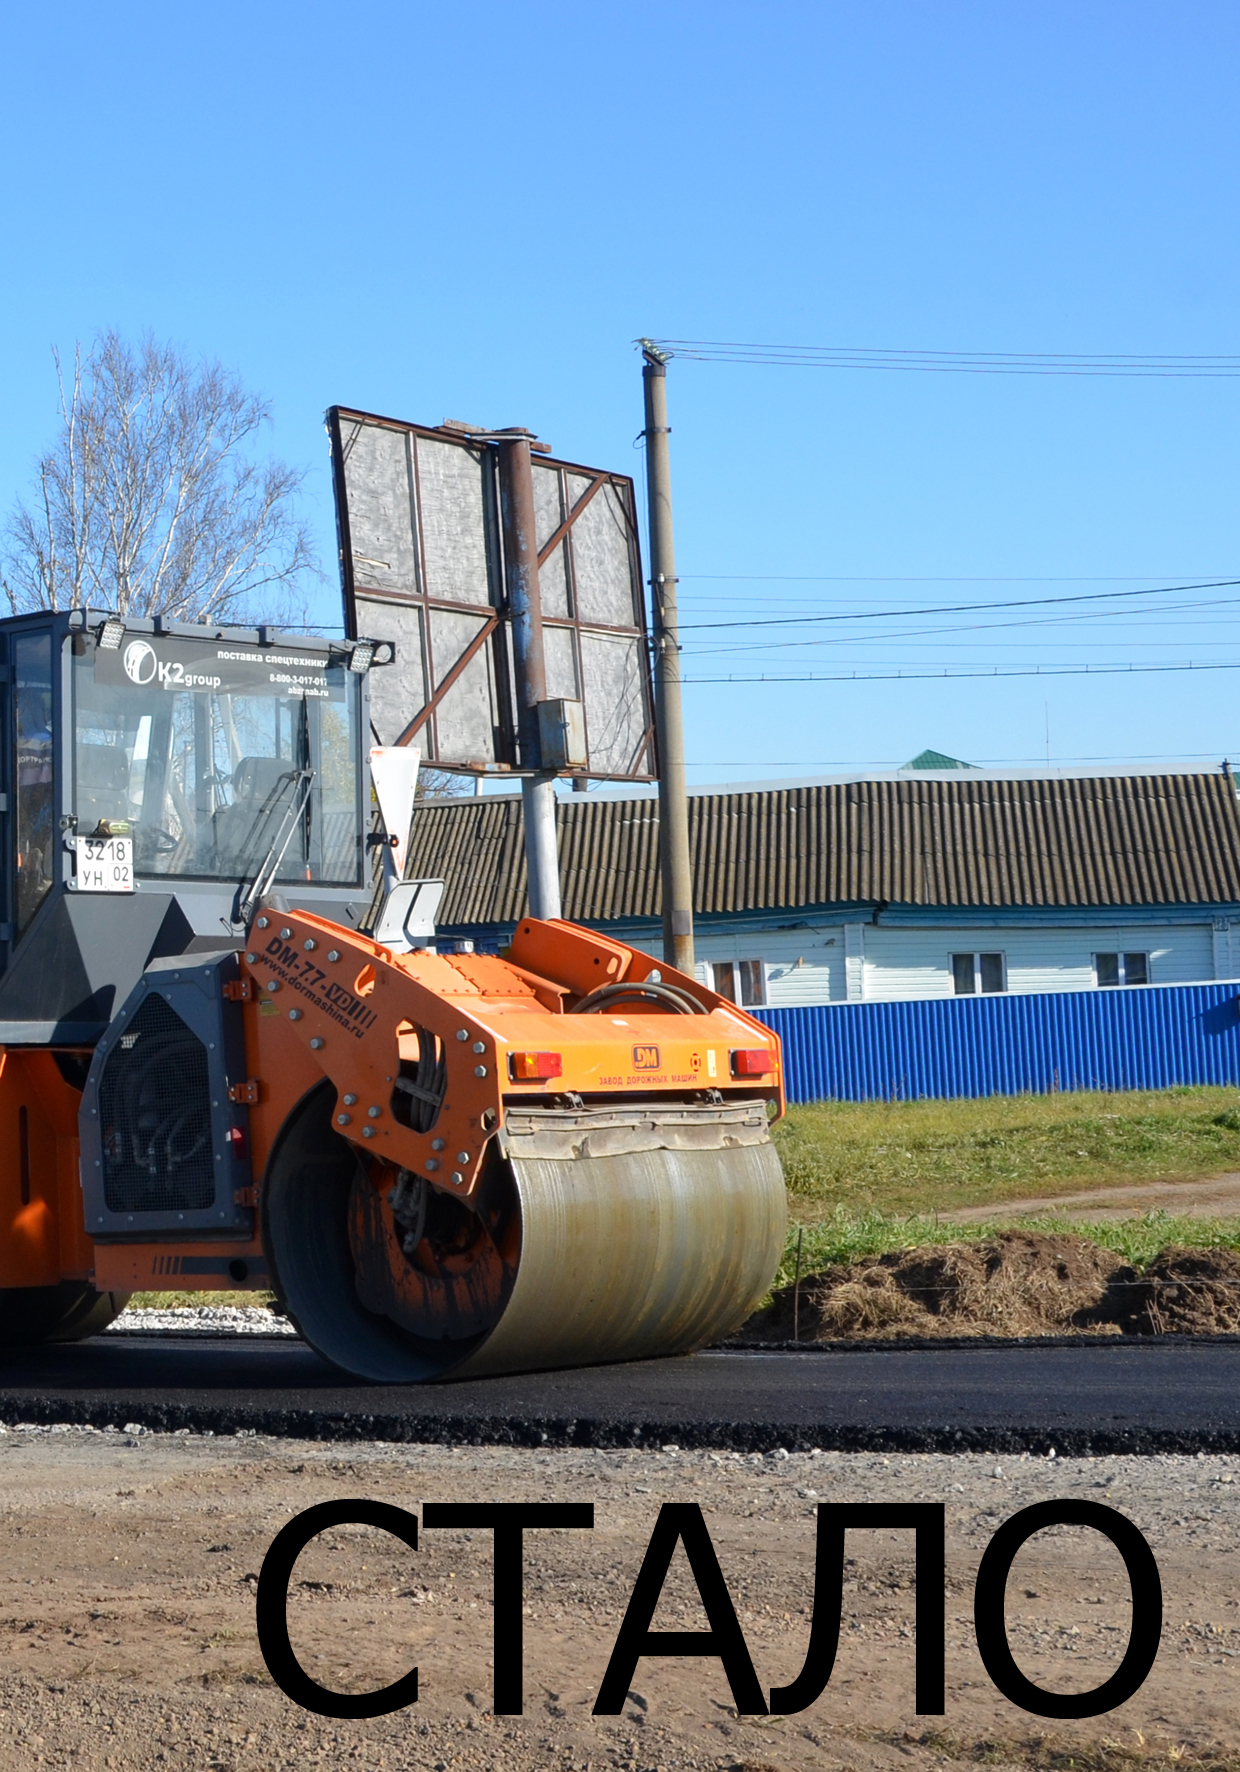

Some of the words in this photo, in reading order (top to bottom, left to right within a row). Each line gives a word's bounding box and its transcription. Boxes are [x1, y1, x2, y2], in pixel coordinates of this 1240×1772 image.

[217, 651, 263, 662] поставка
[158, 661, 221, 689] K2group
[85, 840, 126, 861] 3218
[113, 866, 129, 882] 02
[261, 955, 365, 1039] www.dormashina.ru
[599, 1077, 623, 1086] ЗАВОД
[627, 1075, 668, 1086] ДОРОЖНЫХ
[672, 1074, 697, 1083] МАШИН
